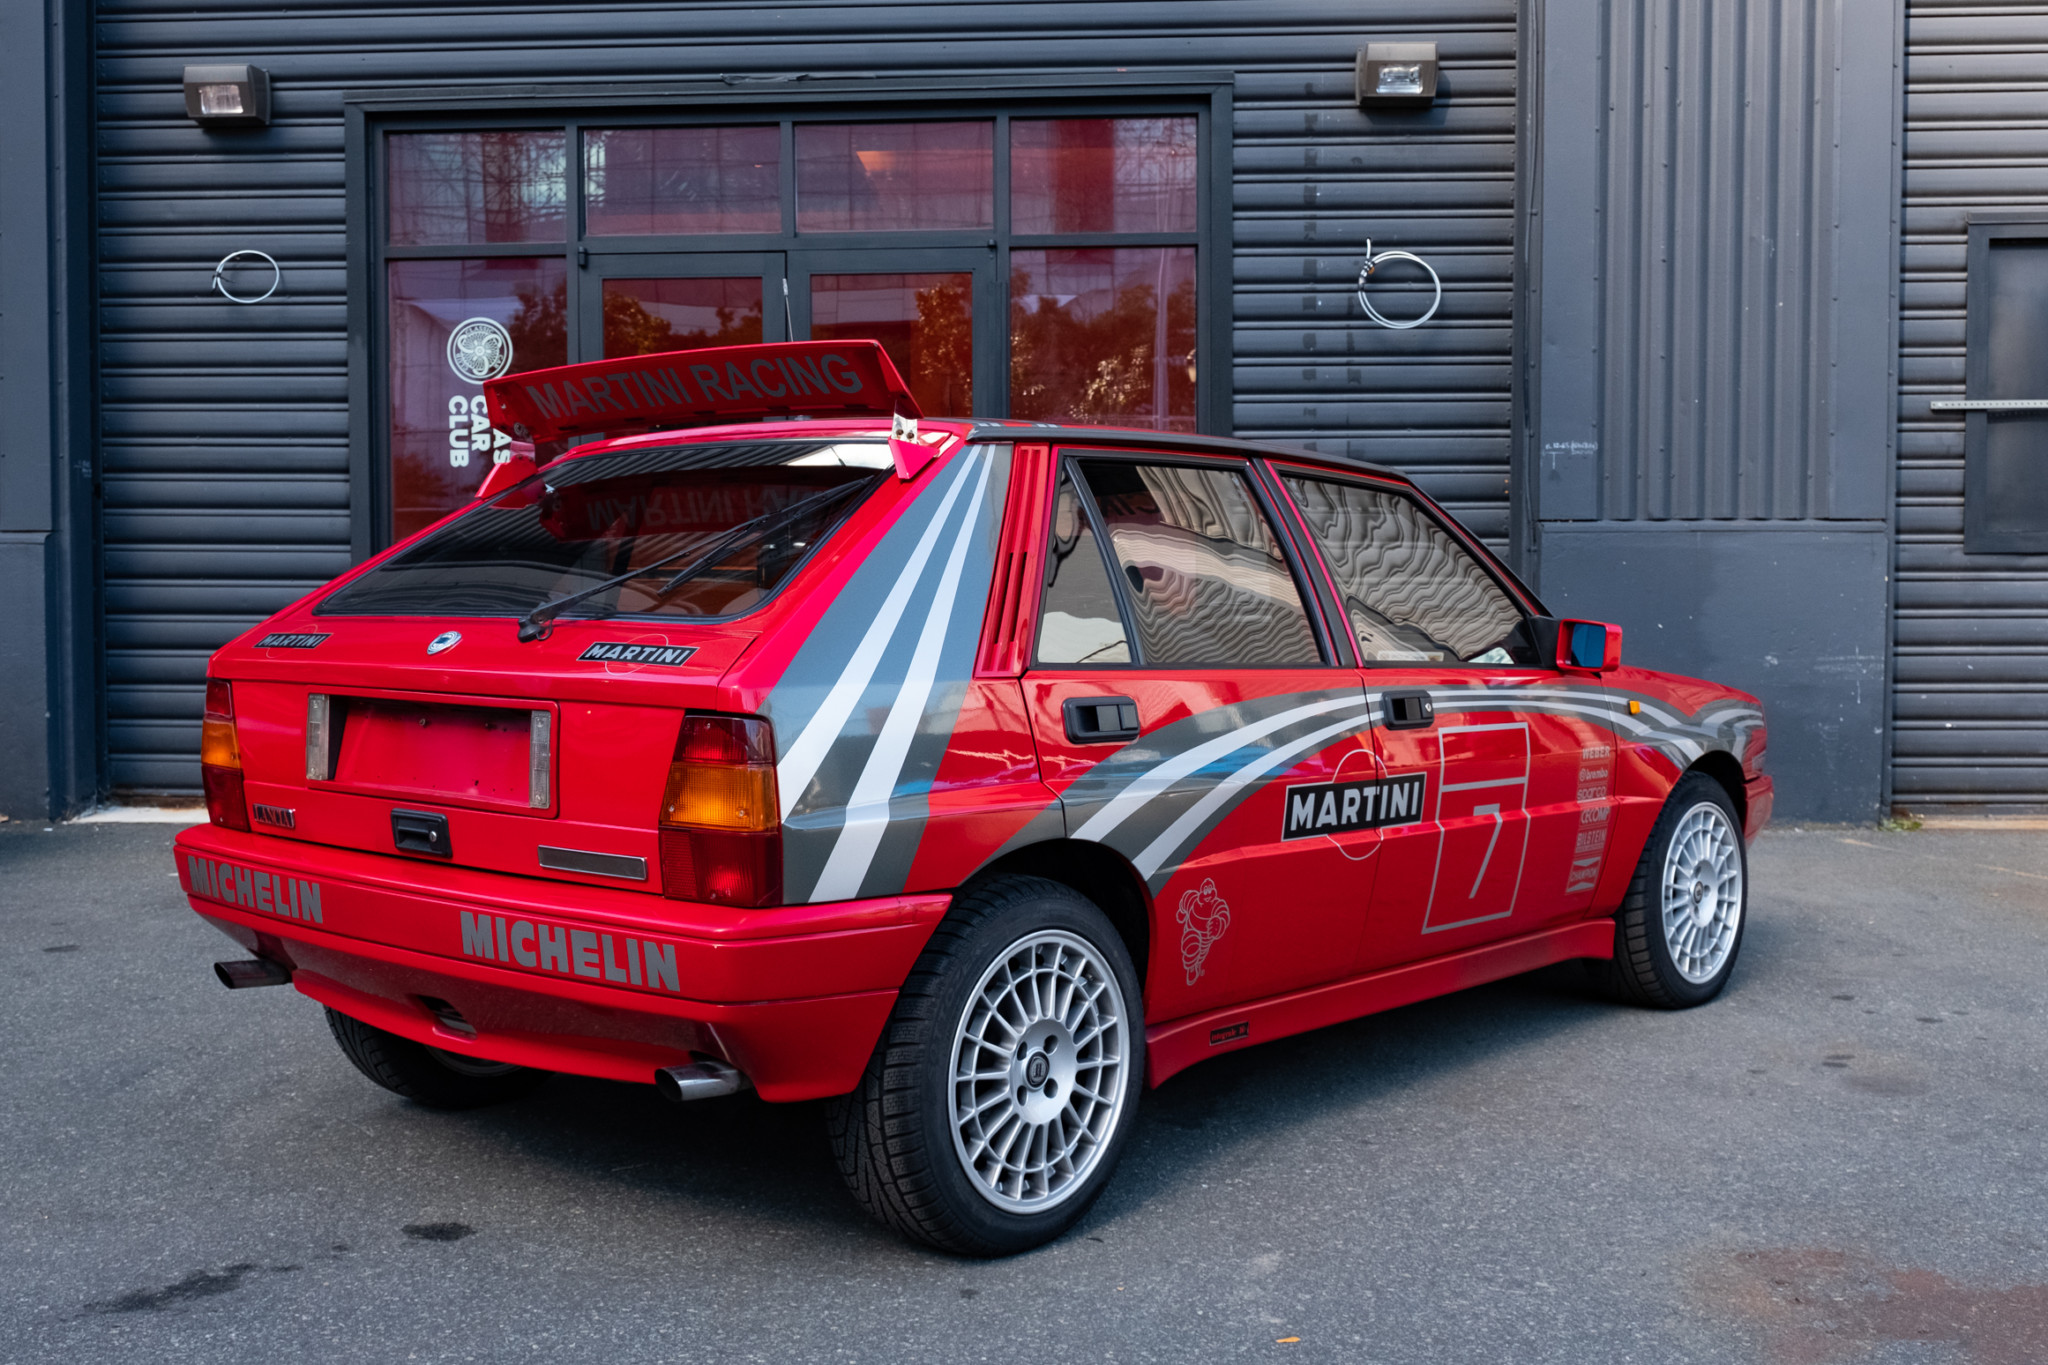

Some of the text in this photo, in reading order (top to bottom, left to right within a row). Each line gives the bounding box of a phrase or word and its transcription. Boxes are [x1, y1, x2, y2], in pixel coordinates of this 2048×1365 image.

[525, 353, 864, 420] MARTINI RACING
[448, 394, 470, 468] CLUB
[470, 394, 491, 452] CAR
[258, 634, 327, 647] MARTINI
[584, 644, 691, 664] MARTINI
[1582, 746, 1611, 760] WEBER
[1585, 768, 1609, 780] brembo
[1290, 781, 1420, 831] MARTINI
[1577, 786, 1606, 800] sparco
[1468, 803, 1503, 899] 7
[1576, 829, 1607, 846] BILSTEIN
[187, 855, 324, 924] MICHELIN
[460, 910, 681, 993] MICHELIN
